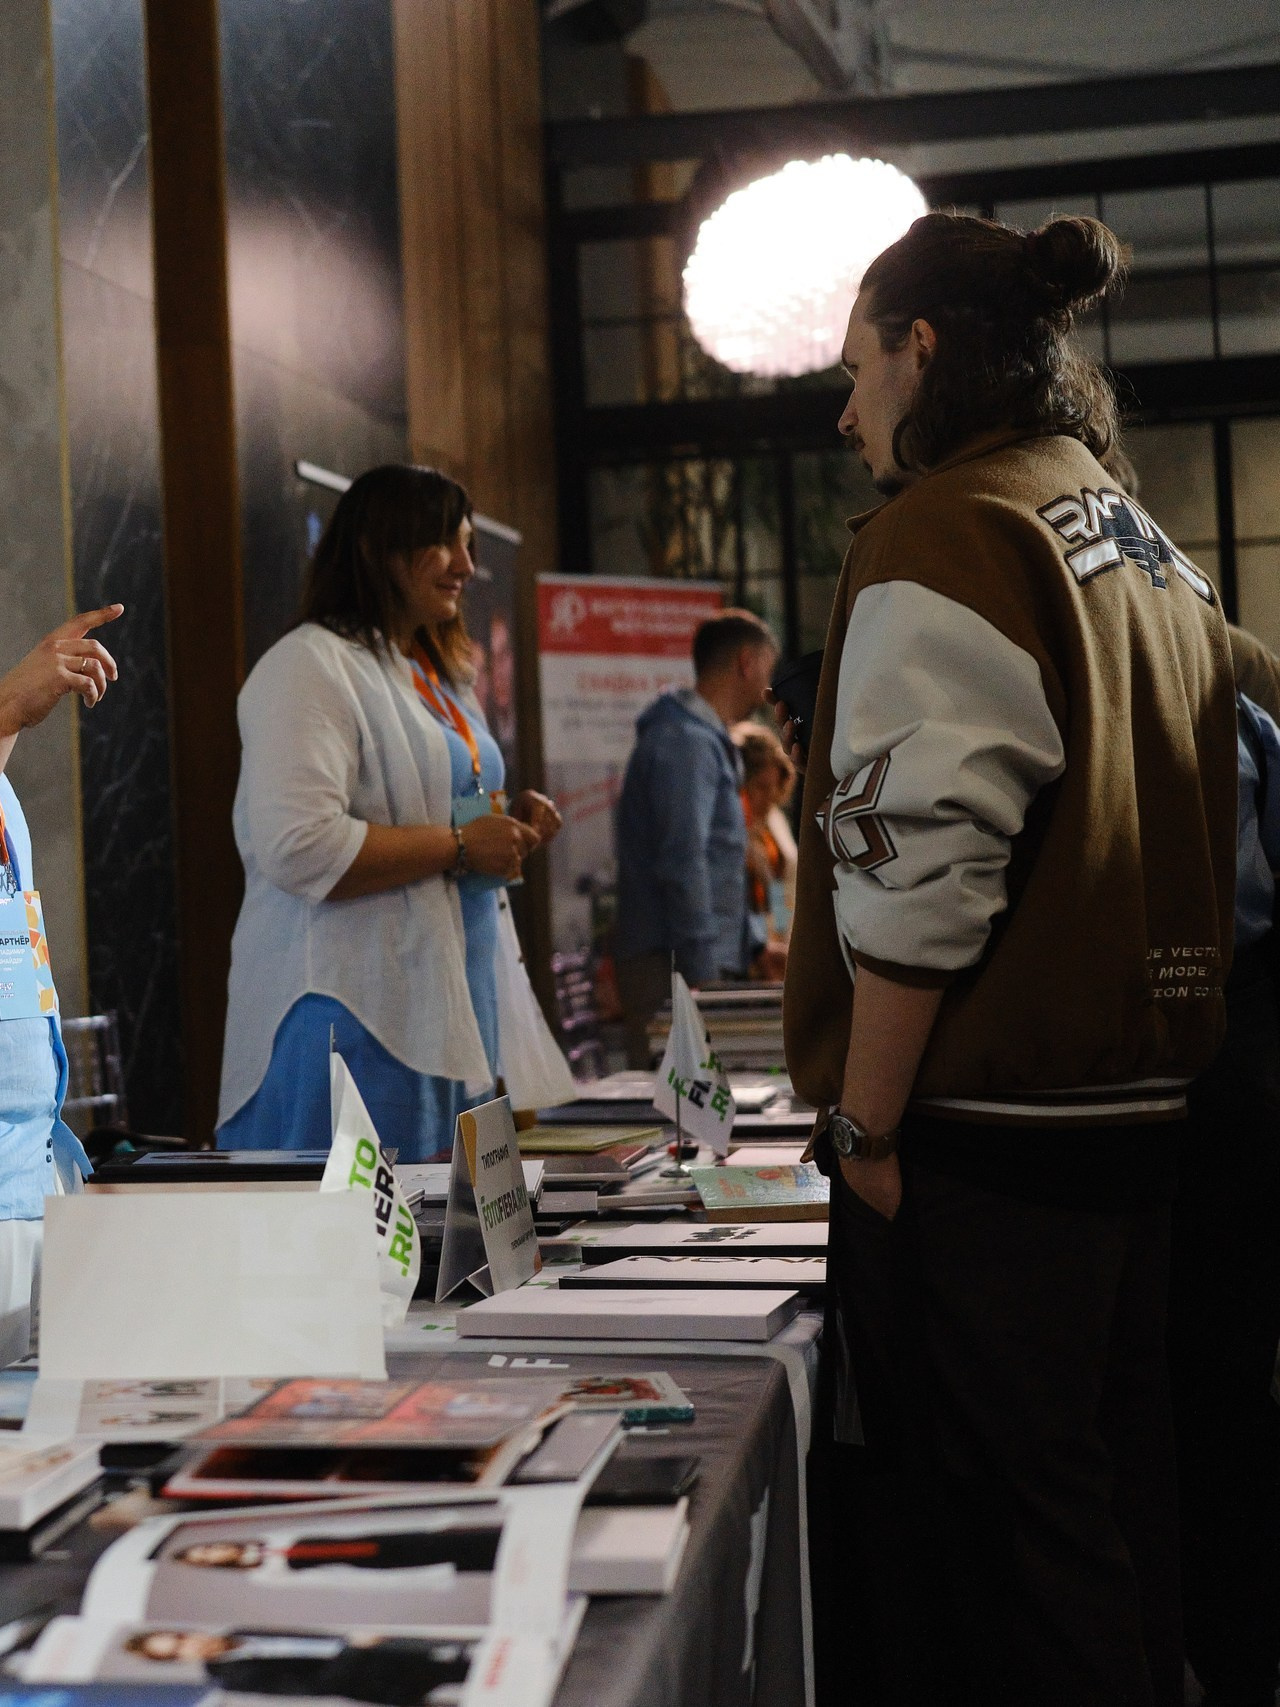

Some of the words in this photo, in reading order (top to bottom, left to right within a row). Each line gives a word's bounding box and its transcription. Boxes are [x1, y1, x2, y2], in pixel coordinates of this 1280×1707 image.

[1158, 966, 1211, 979] MODE
[1153, 986, 1188, 998] ION
[349, 1138, 376, 1190] TO
[388, 1204, 414, 1277] .RU
